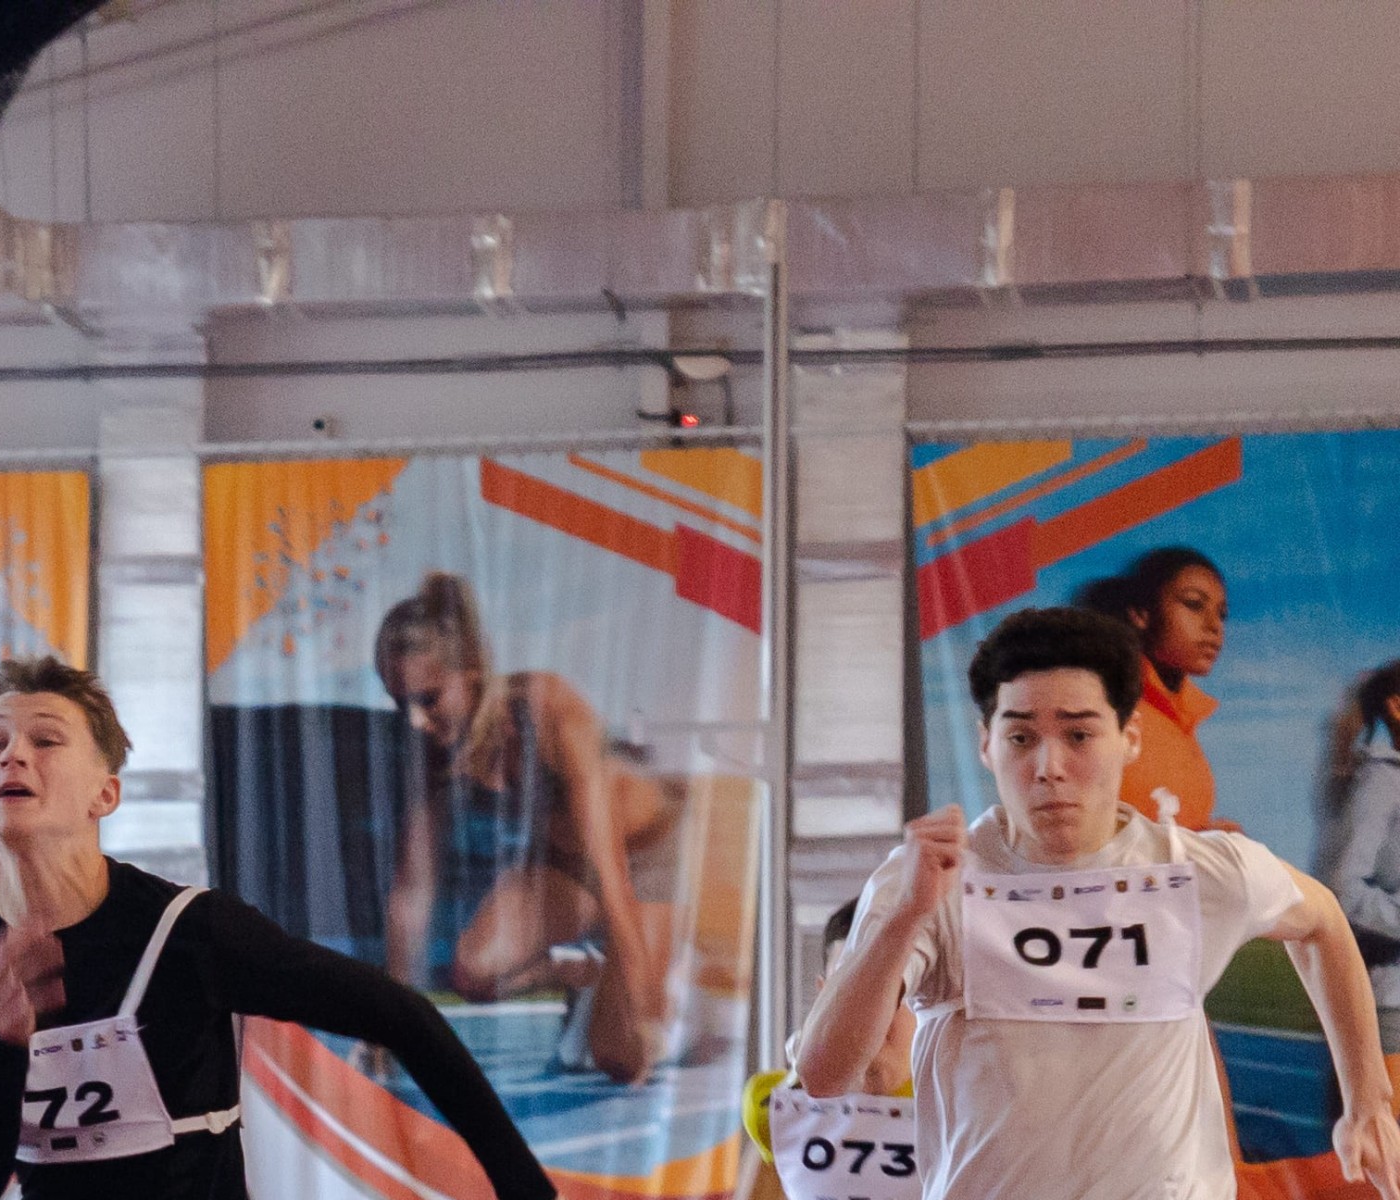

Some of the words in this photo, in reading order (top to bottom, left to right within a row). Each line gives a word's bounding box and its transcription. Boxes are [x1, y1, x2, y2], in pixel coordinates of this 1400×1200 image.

[1013, 923, 1149, 969] 071
[24, 1080, 120, 1130] 72
[802, 1136, 917, 1177] 073
